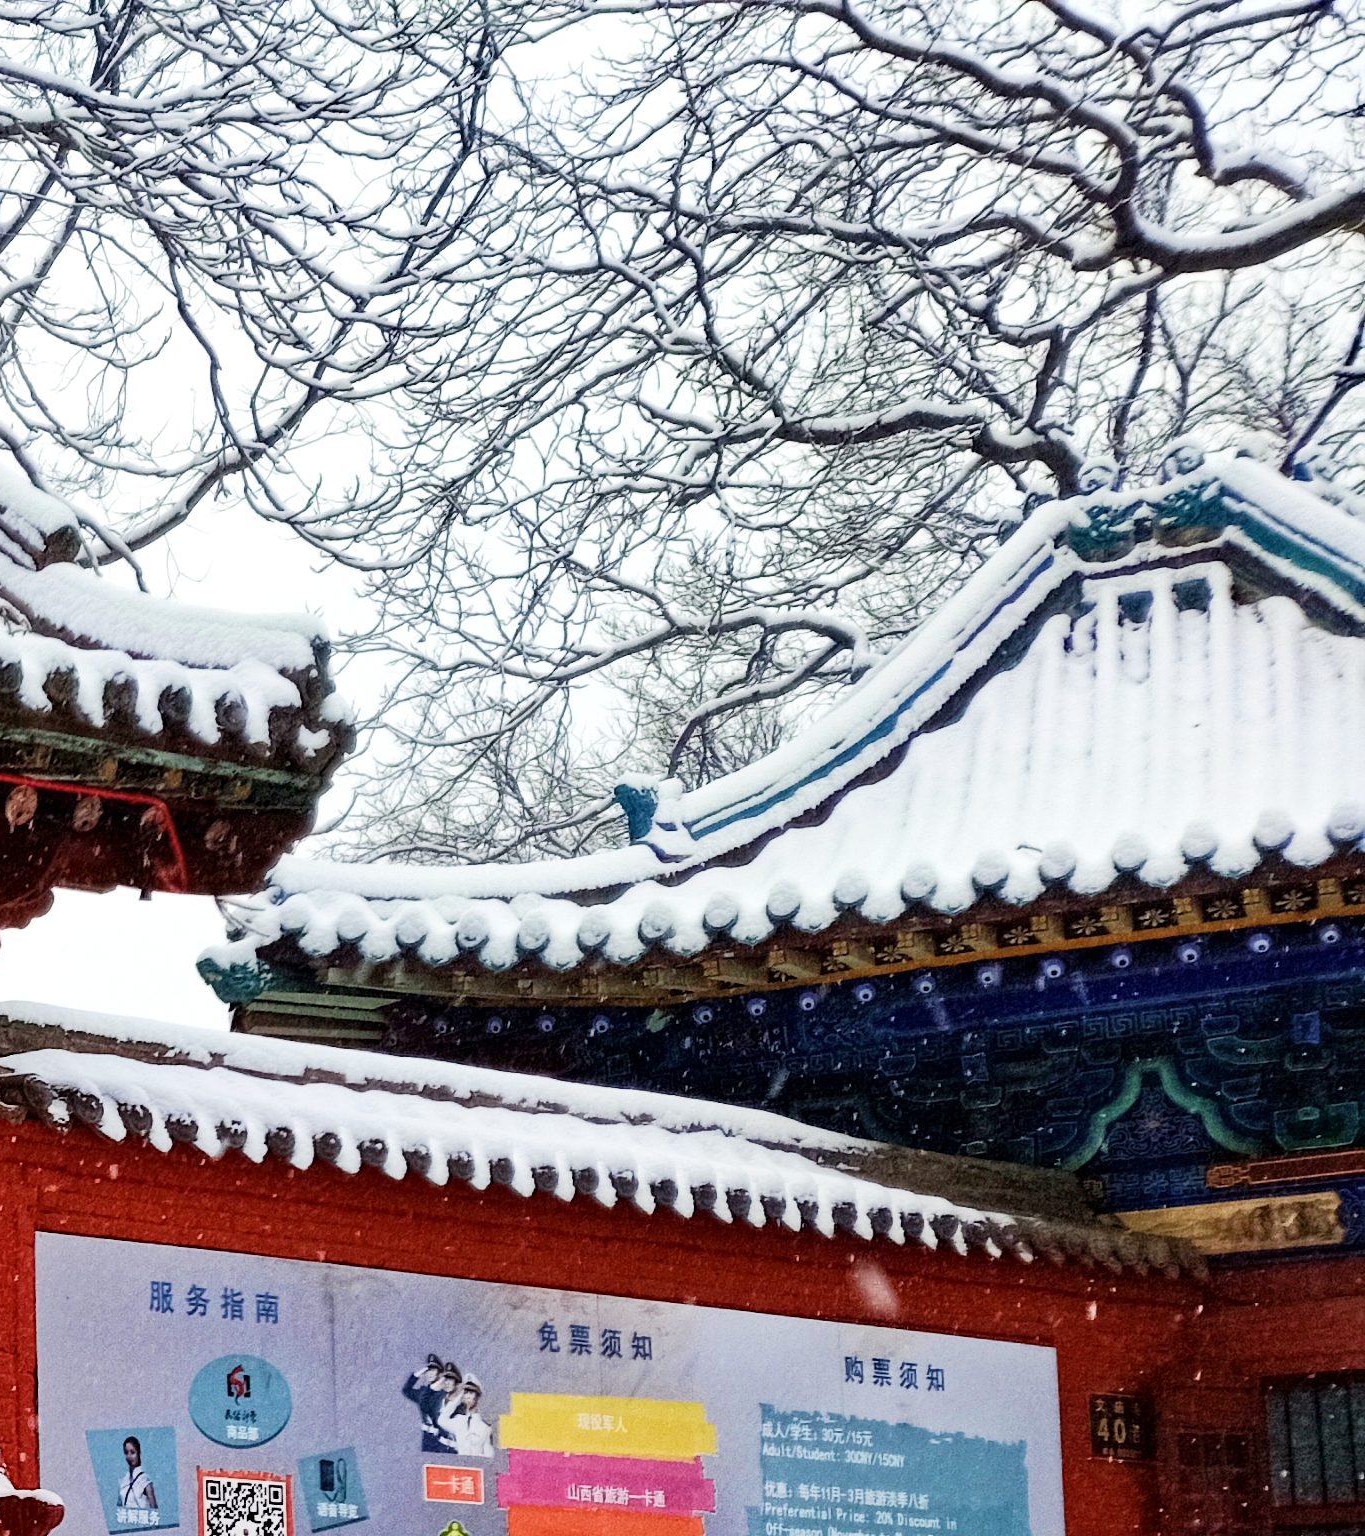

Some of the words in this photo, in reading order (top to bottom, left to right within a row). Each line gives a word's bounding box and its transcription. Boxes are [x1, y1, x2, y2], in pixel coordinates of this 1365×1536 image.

[149, 1280, 280, 1325] 服务指南
[538, 1321, 654, 1361] 免票须知
[844, 1356, 945, 1392] 购票须知
[226, 1424, 260, 1442] 商品部
[577, 1412, 628, 1434] 现役军人
[432, 1475, 475, 1495] 一卡通
[567, 1483, 666, 1508] 山西省旅游一卡通
[116, 1508, 161, 1526] 讲解服务
[316, 1501, 360, 1519] 语音导览
[765, 1502, 832, 1520] Preferential
[875, 1510, 894, 1526] 20%
[897, 1512, 942, 1530] Discount
[946, 1517, 958, 1531] in
